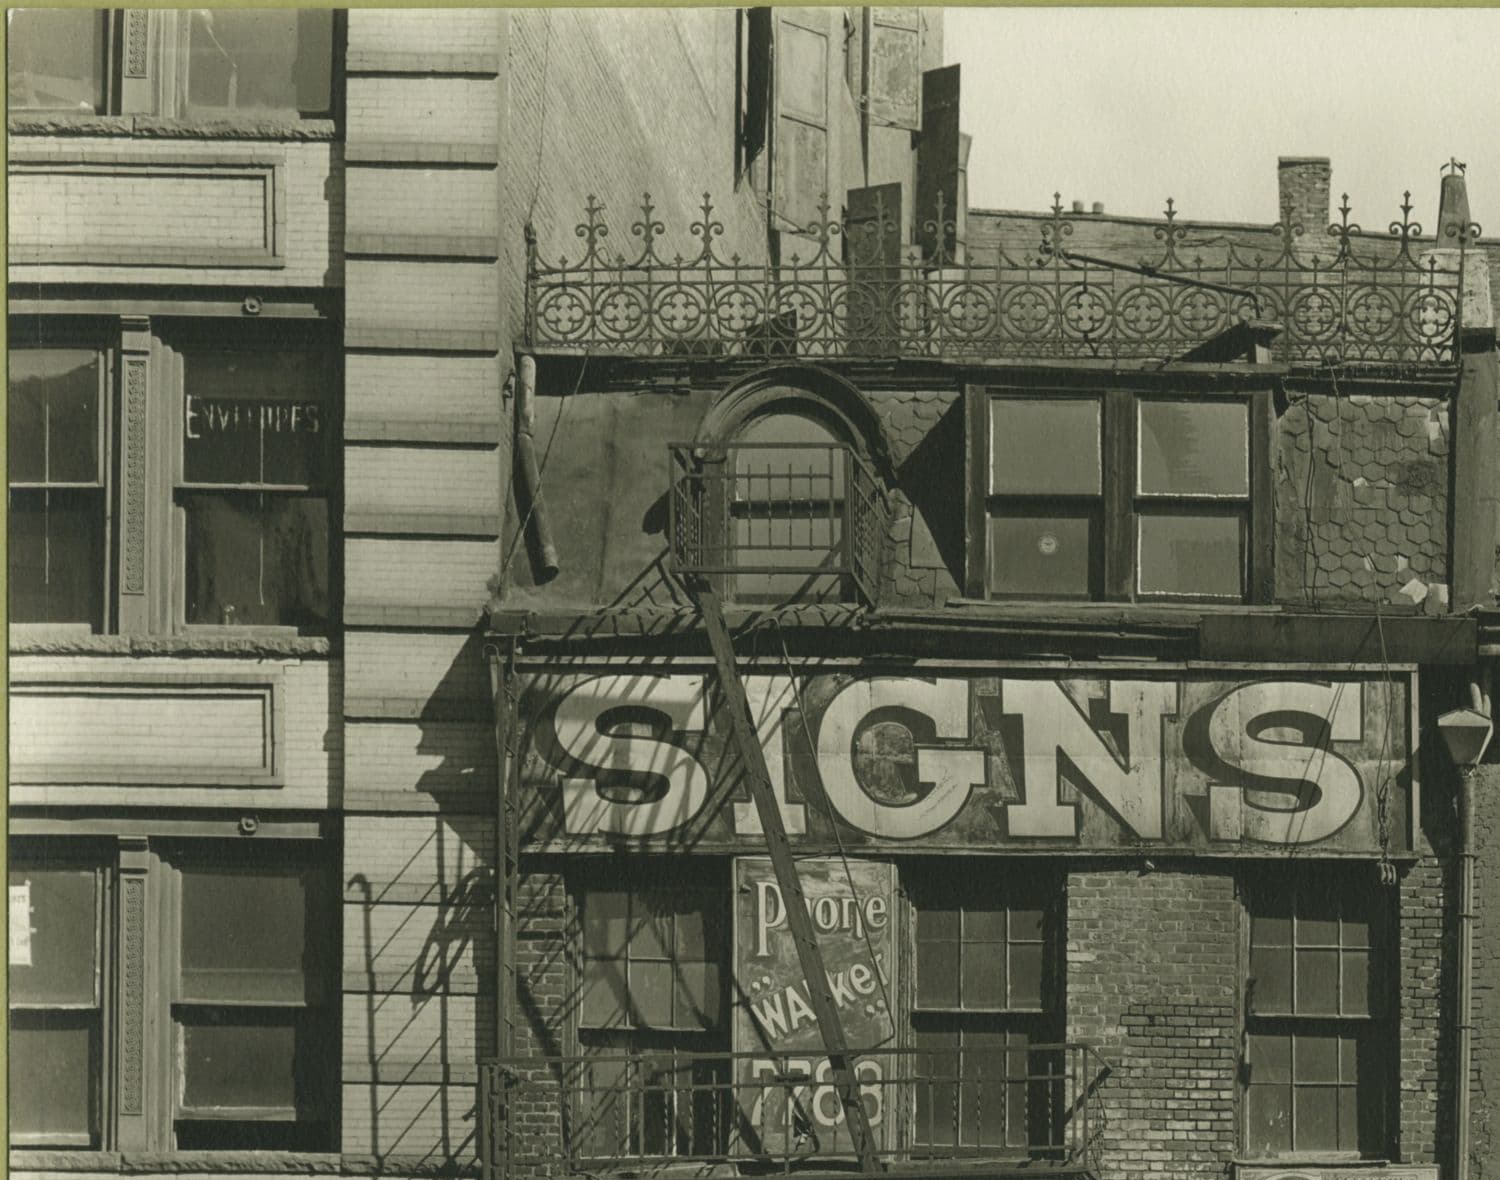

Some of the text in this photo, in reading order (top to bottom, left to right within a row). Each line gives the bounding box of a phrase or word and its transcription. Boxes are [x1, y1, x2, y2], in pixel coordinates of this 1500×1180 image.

[186, 394, 320, 438] ENVOPES
[555, 674, 1364, 843] SIGNS
[756, 881, 888, 956] Pone
[751, 1059, 883, 1126] 7788
